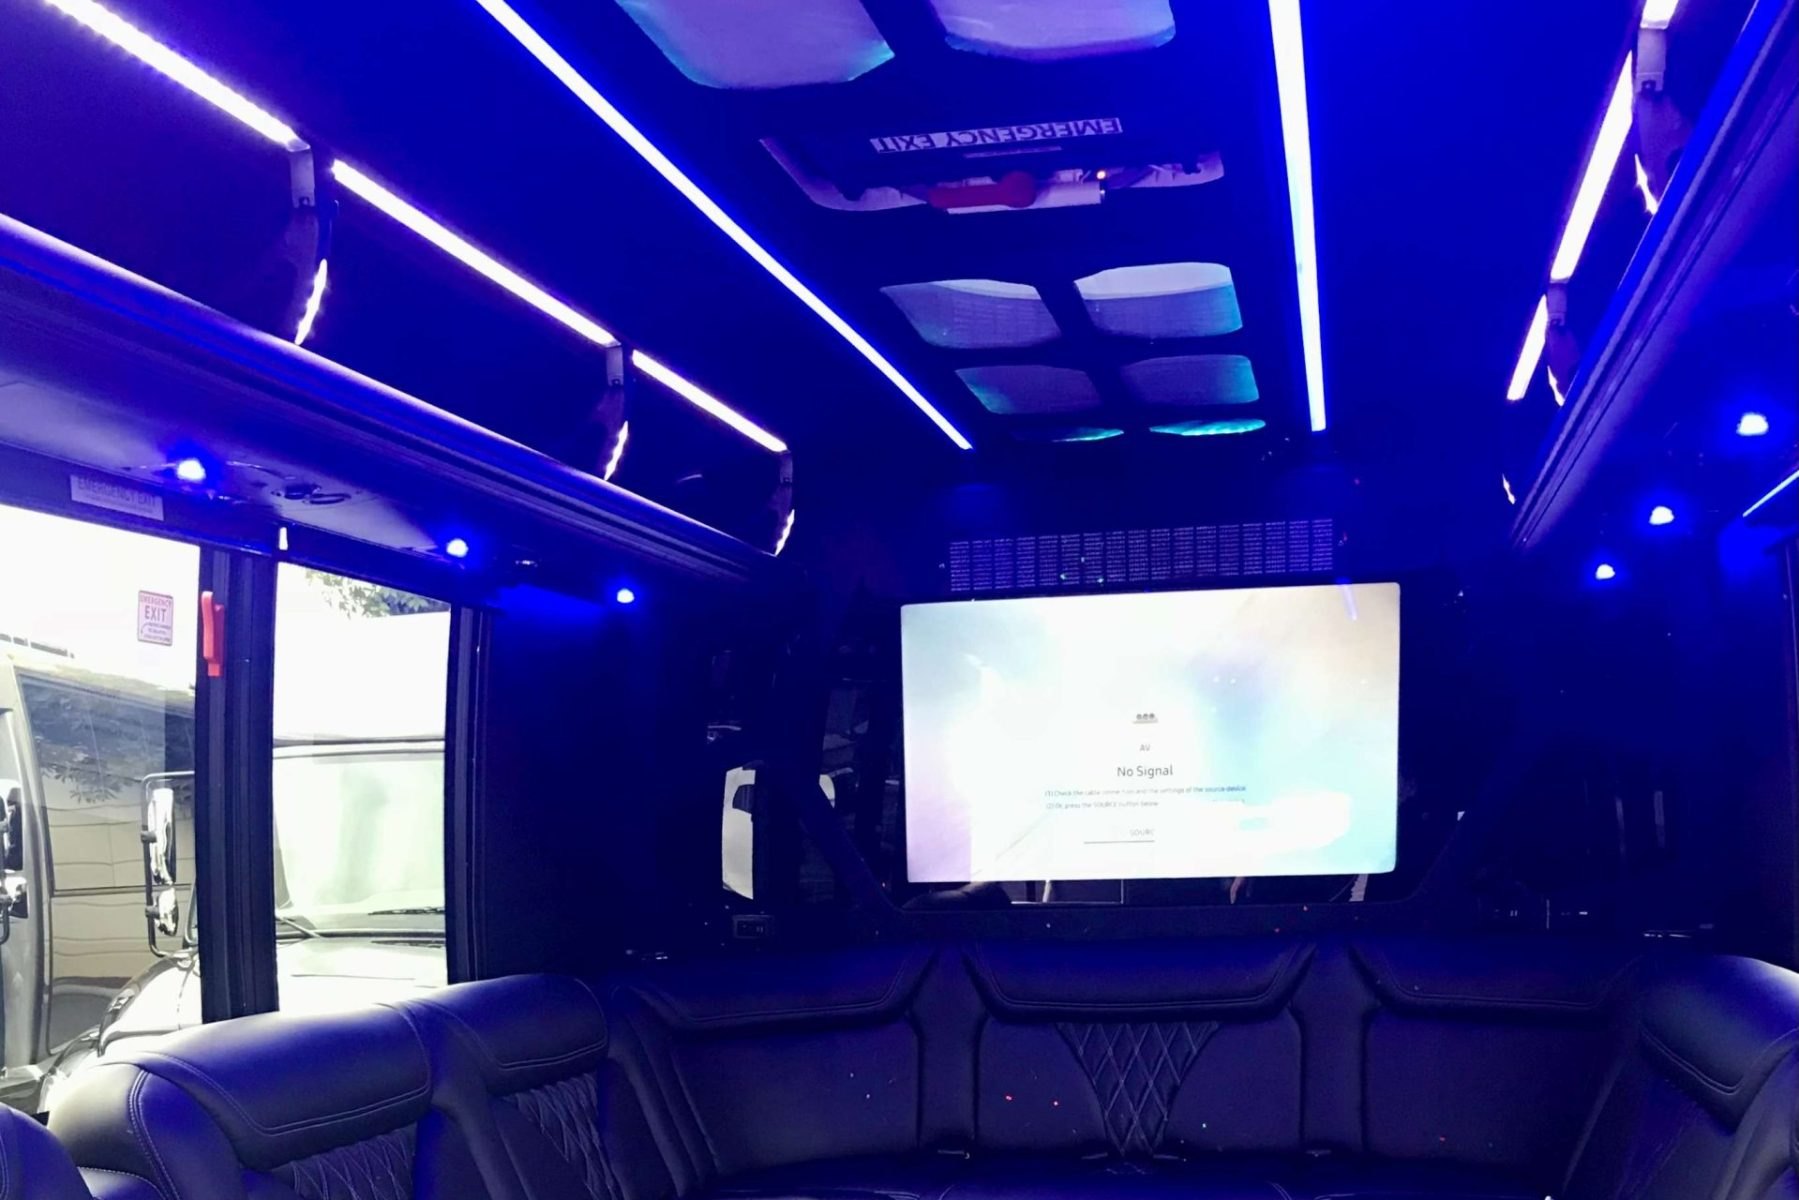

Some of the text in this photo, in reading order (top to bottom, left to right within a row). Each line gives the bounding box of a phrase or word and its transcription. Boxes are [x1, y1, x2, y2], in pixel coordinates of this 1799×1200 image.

[947, 118, 1120, 146] EMERGENCY
[876, 134, 937, 152] EXIT
[79, 478, 136, 504] EMERGENCY
[138, 493, 156, 508] EXIT
[144, 604, 167, 622] EXIT
[1117, 763, 1173, 779] No Signal
